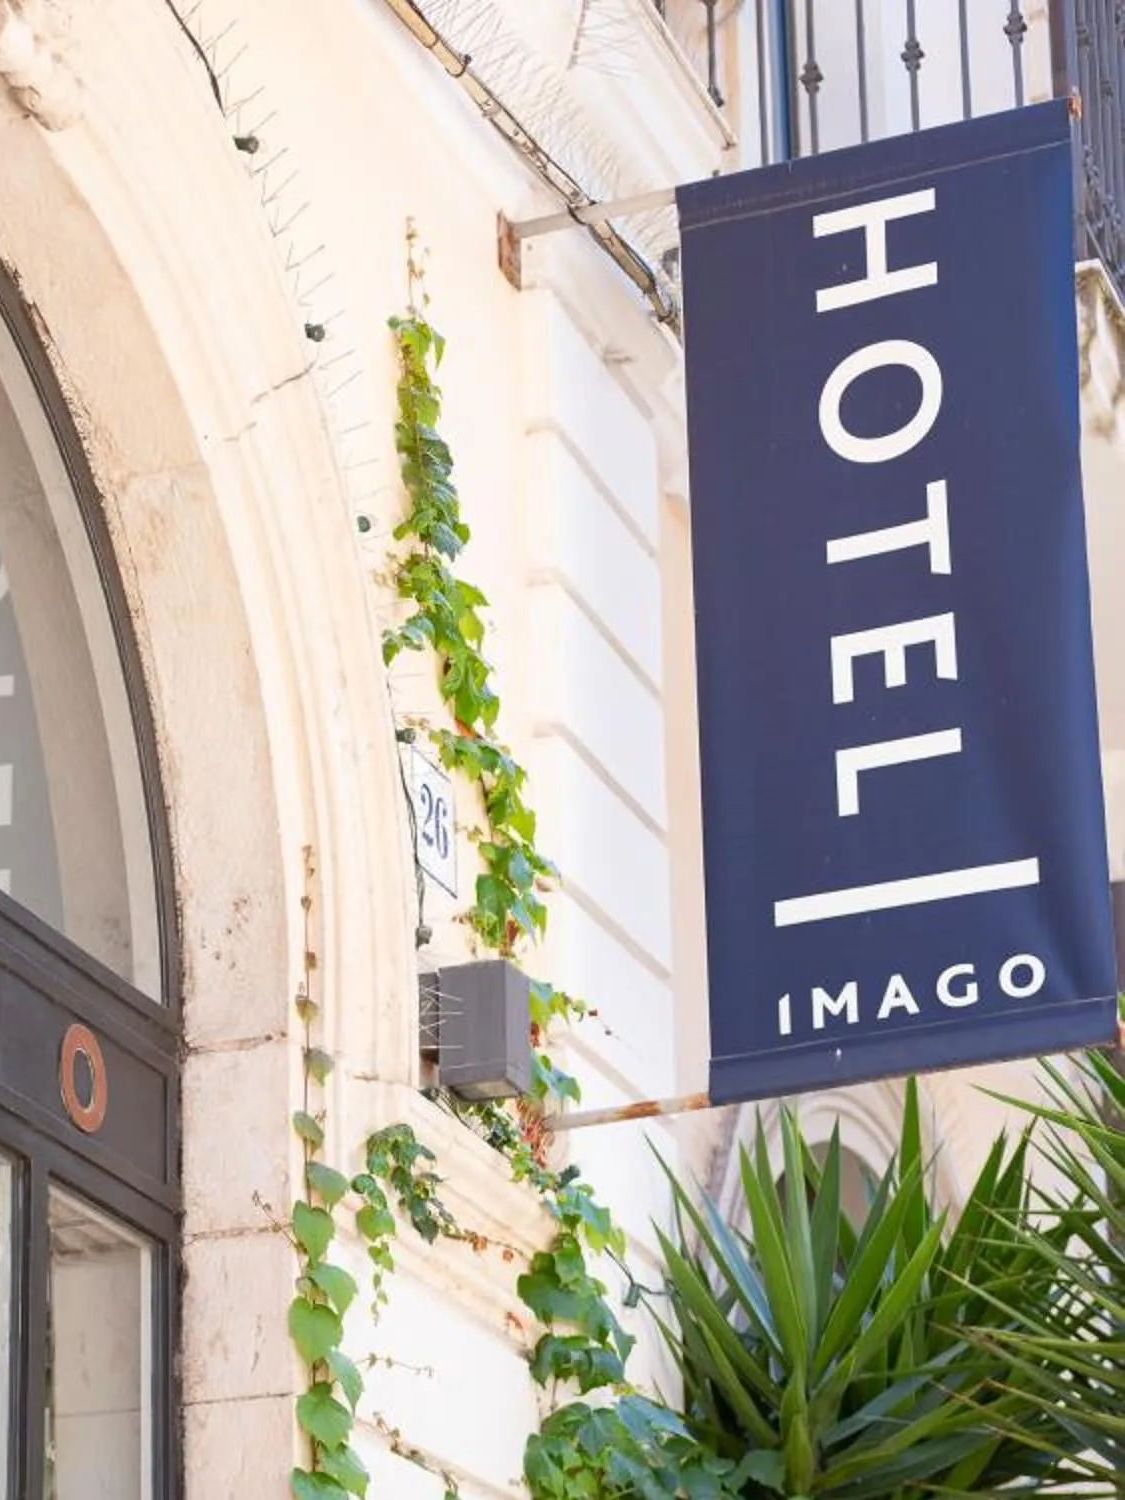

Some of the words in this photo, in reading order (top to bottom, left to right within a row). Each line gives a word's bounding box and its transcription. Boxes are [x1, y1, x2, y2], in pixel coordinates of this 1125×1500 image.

[812, 187, 962, 817] HOTEL
[420, 783, 448, 859] 26
[778, 954, 1047, 1035] IMAGO
